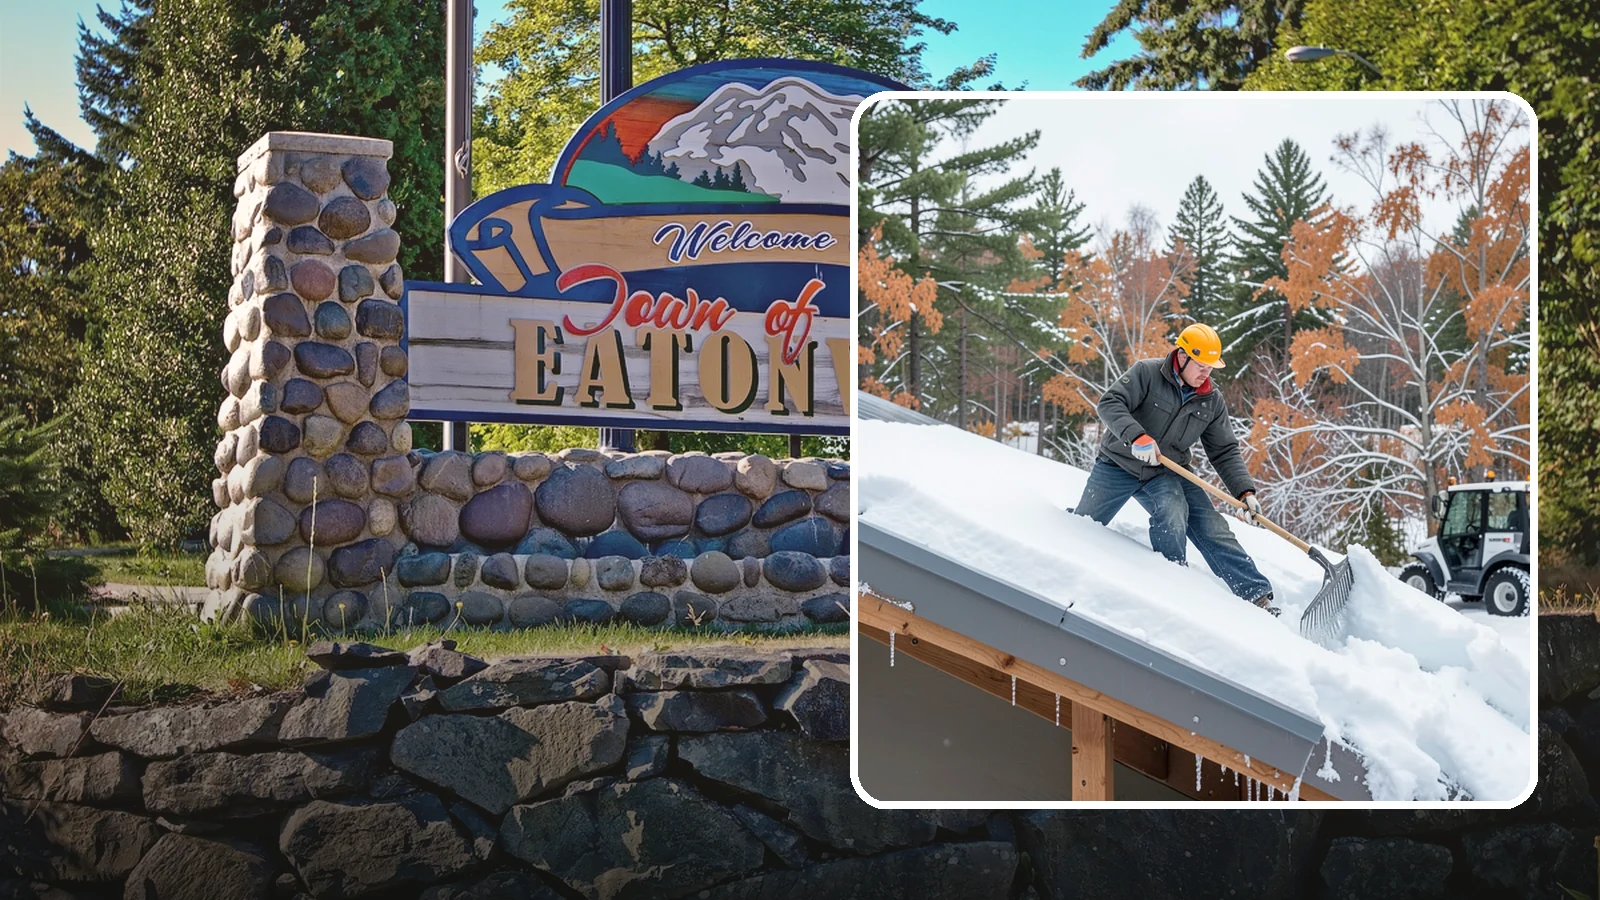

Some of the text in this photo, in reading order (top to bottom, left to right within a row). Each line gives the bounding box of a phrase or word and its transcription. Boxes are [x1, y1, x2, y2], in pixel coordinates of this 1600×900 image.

[653, 220, 837, 263] Welcome
[556, 263, 826, 365] Town of
